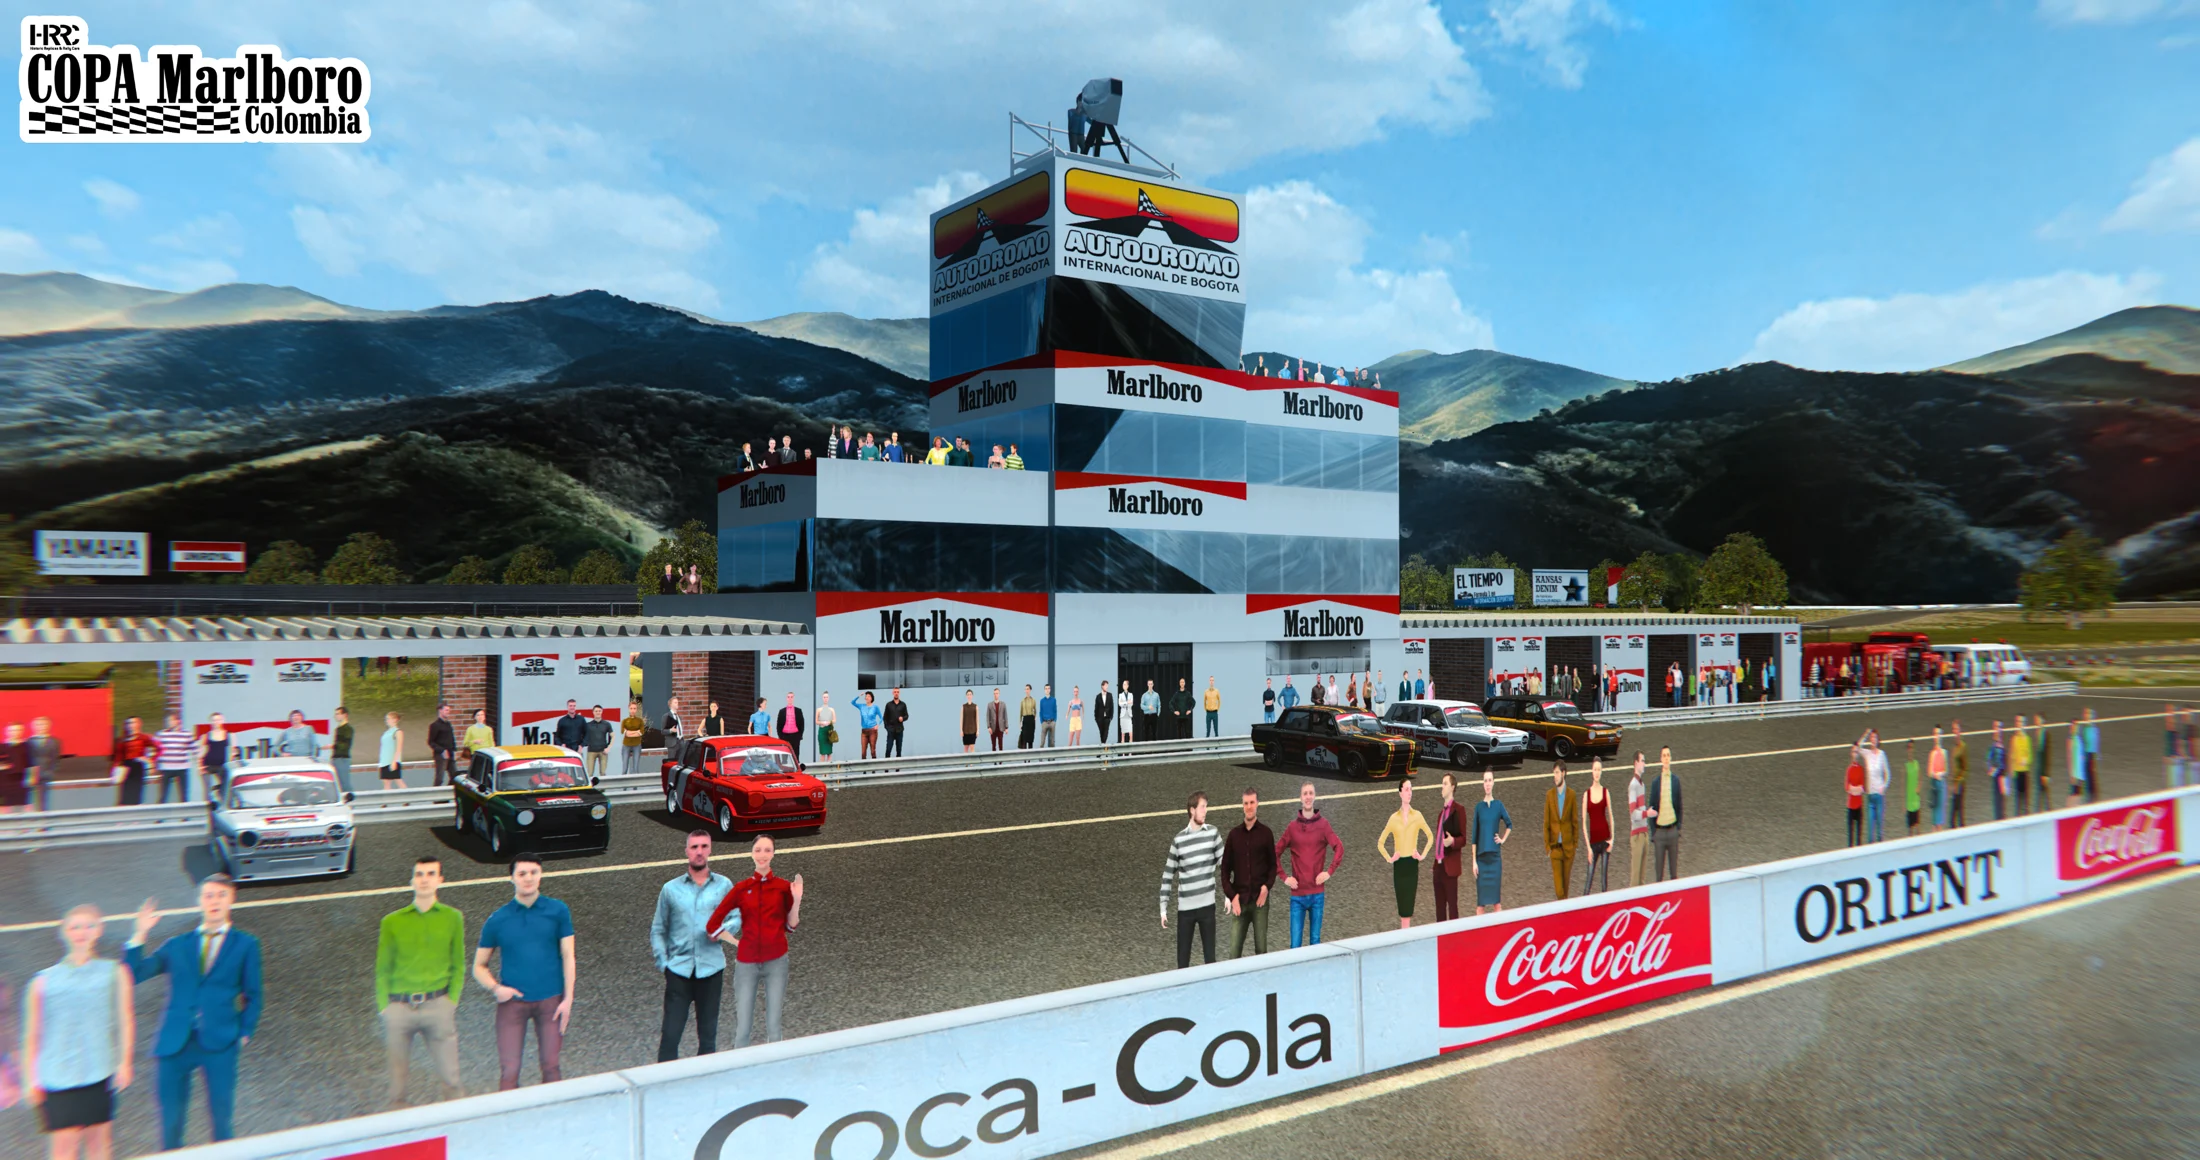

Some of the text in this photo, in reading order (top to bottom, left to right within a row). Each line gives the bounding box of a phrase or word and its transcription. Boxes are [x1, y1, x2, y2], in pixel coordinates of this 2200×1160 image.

[933, 231, 1050, 293] AUTODROMO
[1064, 229, 1240, 279] AUTODROMO
[933, 257, 1050, 307] INTERNACIONAL DE BOGOTA
[1064, 256, 1240, 294] INTERNACIONAL DE BOGOTA
[958, 378, 1017, 413] Marlboro
[1107, 369, 1203, 404] Marlboro
[1283, 390, 1364, 421] Marlboro
[739, 481, 786, 509] Marlboro
[1107, 487, 1204, 517] Marlboro
[44, 538, 140, 559] YAMAHA
[1456, 571, 1503, 589] EL TIEMPO
[1535, 575, 1562, 584] KANSAS
[1535, 584, 1558, 592] DENIM
[880, 609, 995, 643] Marlboro
[1283, 609, 1364, 637] Marlboro
[290, 663, 315, 671] 37
[525, 658, 544, 667] 38
[588, 657, 607, 665] 39
[780, 653, 796, 661] 40
[1383, 725, 1415, 738] RTEGA
[1424, 740, 1438, 748] 05
[1309, 756, 1336, 769] Marlboro
[1315, 747, 1327, 757] 21
[1795, 850, 2001, 944] ORIENT
[1485, 899, 1682, 1007] Coca-Cola
